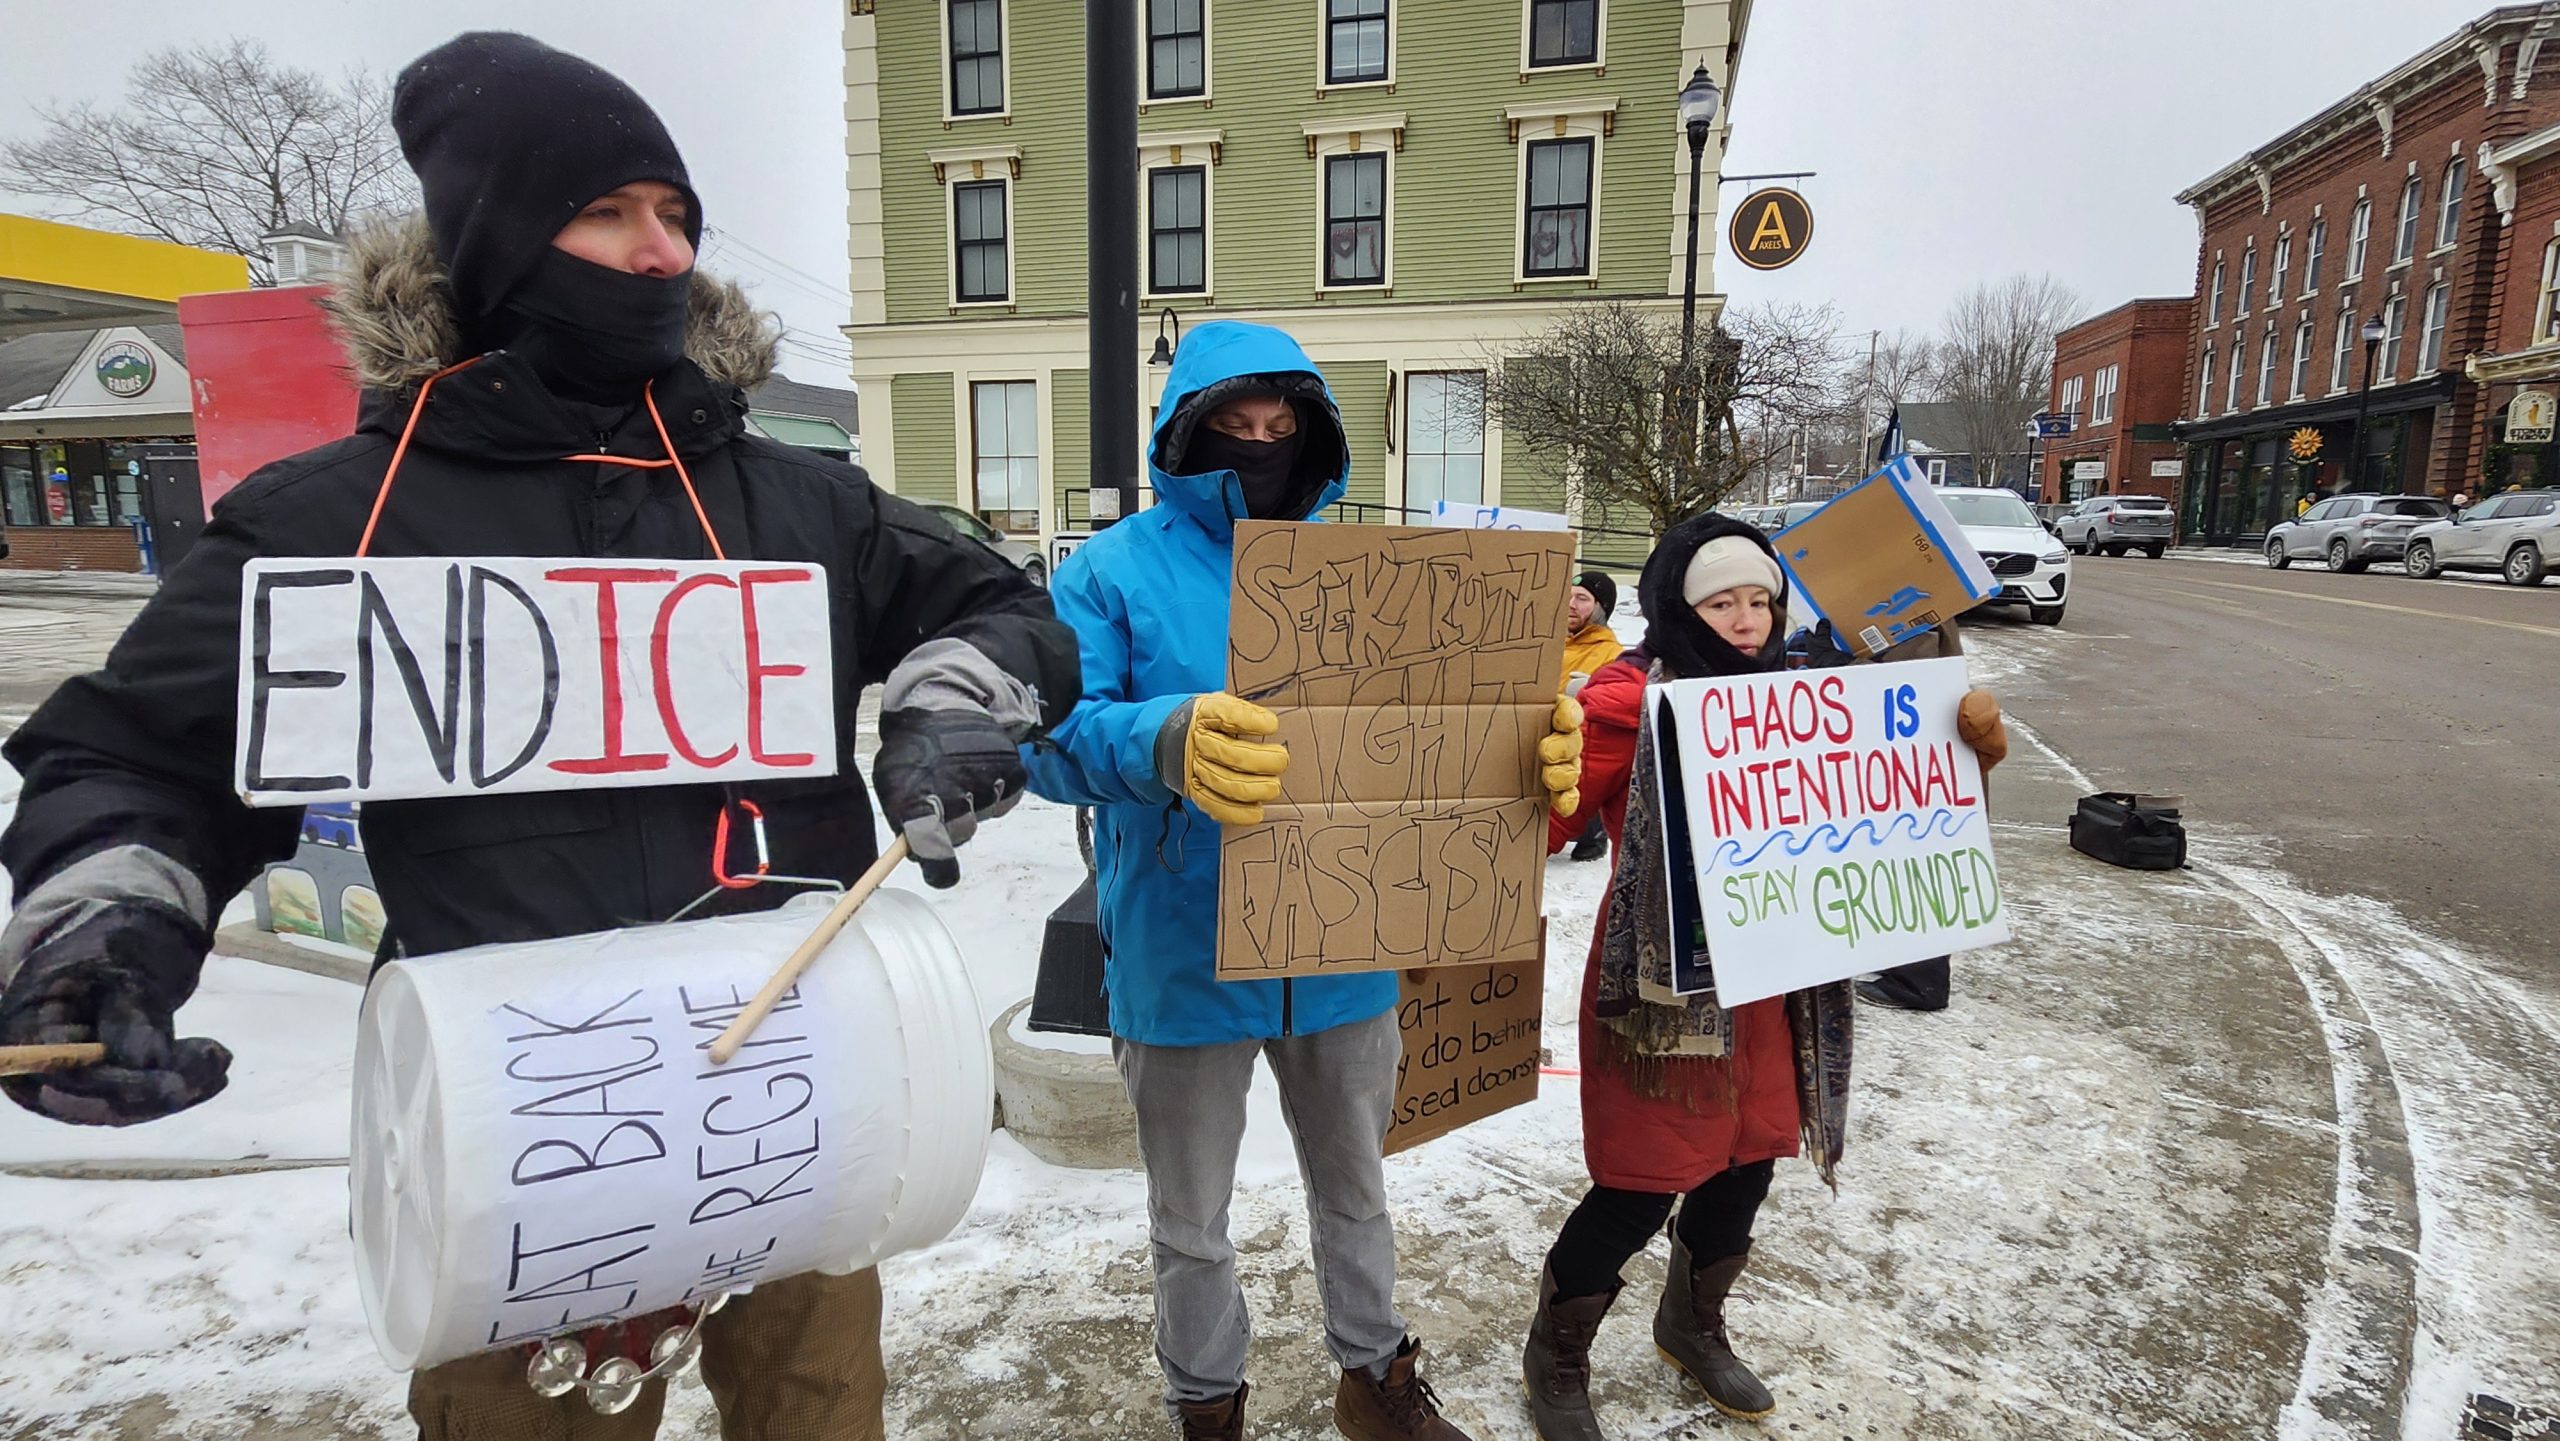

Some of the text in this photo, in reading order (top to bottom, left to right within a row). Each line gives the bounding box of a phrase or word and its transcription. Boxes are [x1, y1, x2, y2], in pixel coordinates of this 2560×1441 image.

[1749, 201, 1791, 251] A
[1759, 241, 1782, 250] AXELS
[107, 374, 142, 392] FARMS
[1231, 528, 1573, 697] SEEK TRUTH
[245, 563, 817, 792] END ICE
[1701, 675, 1921, 760] CHAOS IS
[1236, 643, 1543, 820] IGHT
[1706, 741, 1977, 839] INTENTIONAL
[1219, 803, 1542, 971] FASCISM
[1723, 847, 1999, 948] STAY GROUNDED
[1399, 965, 1519, 1031] at do
[1421, 1011, 1542, 1069] do behind
[1387, 1078, 1460, 1135] osed
[1467, 1050, 1541, 1096] doors?
[488, 988, 666, 1344] EAT BACK
[679, 983, 821, 1301] THE REGIME
